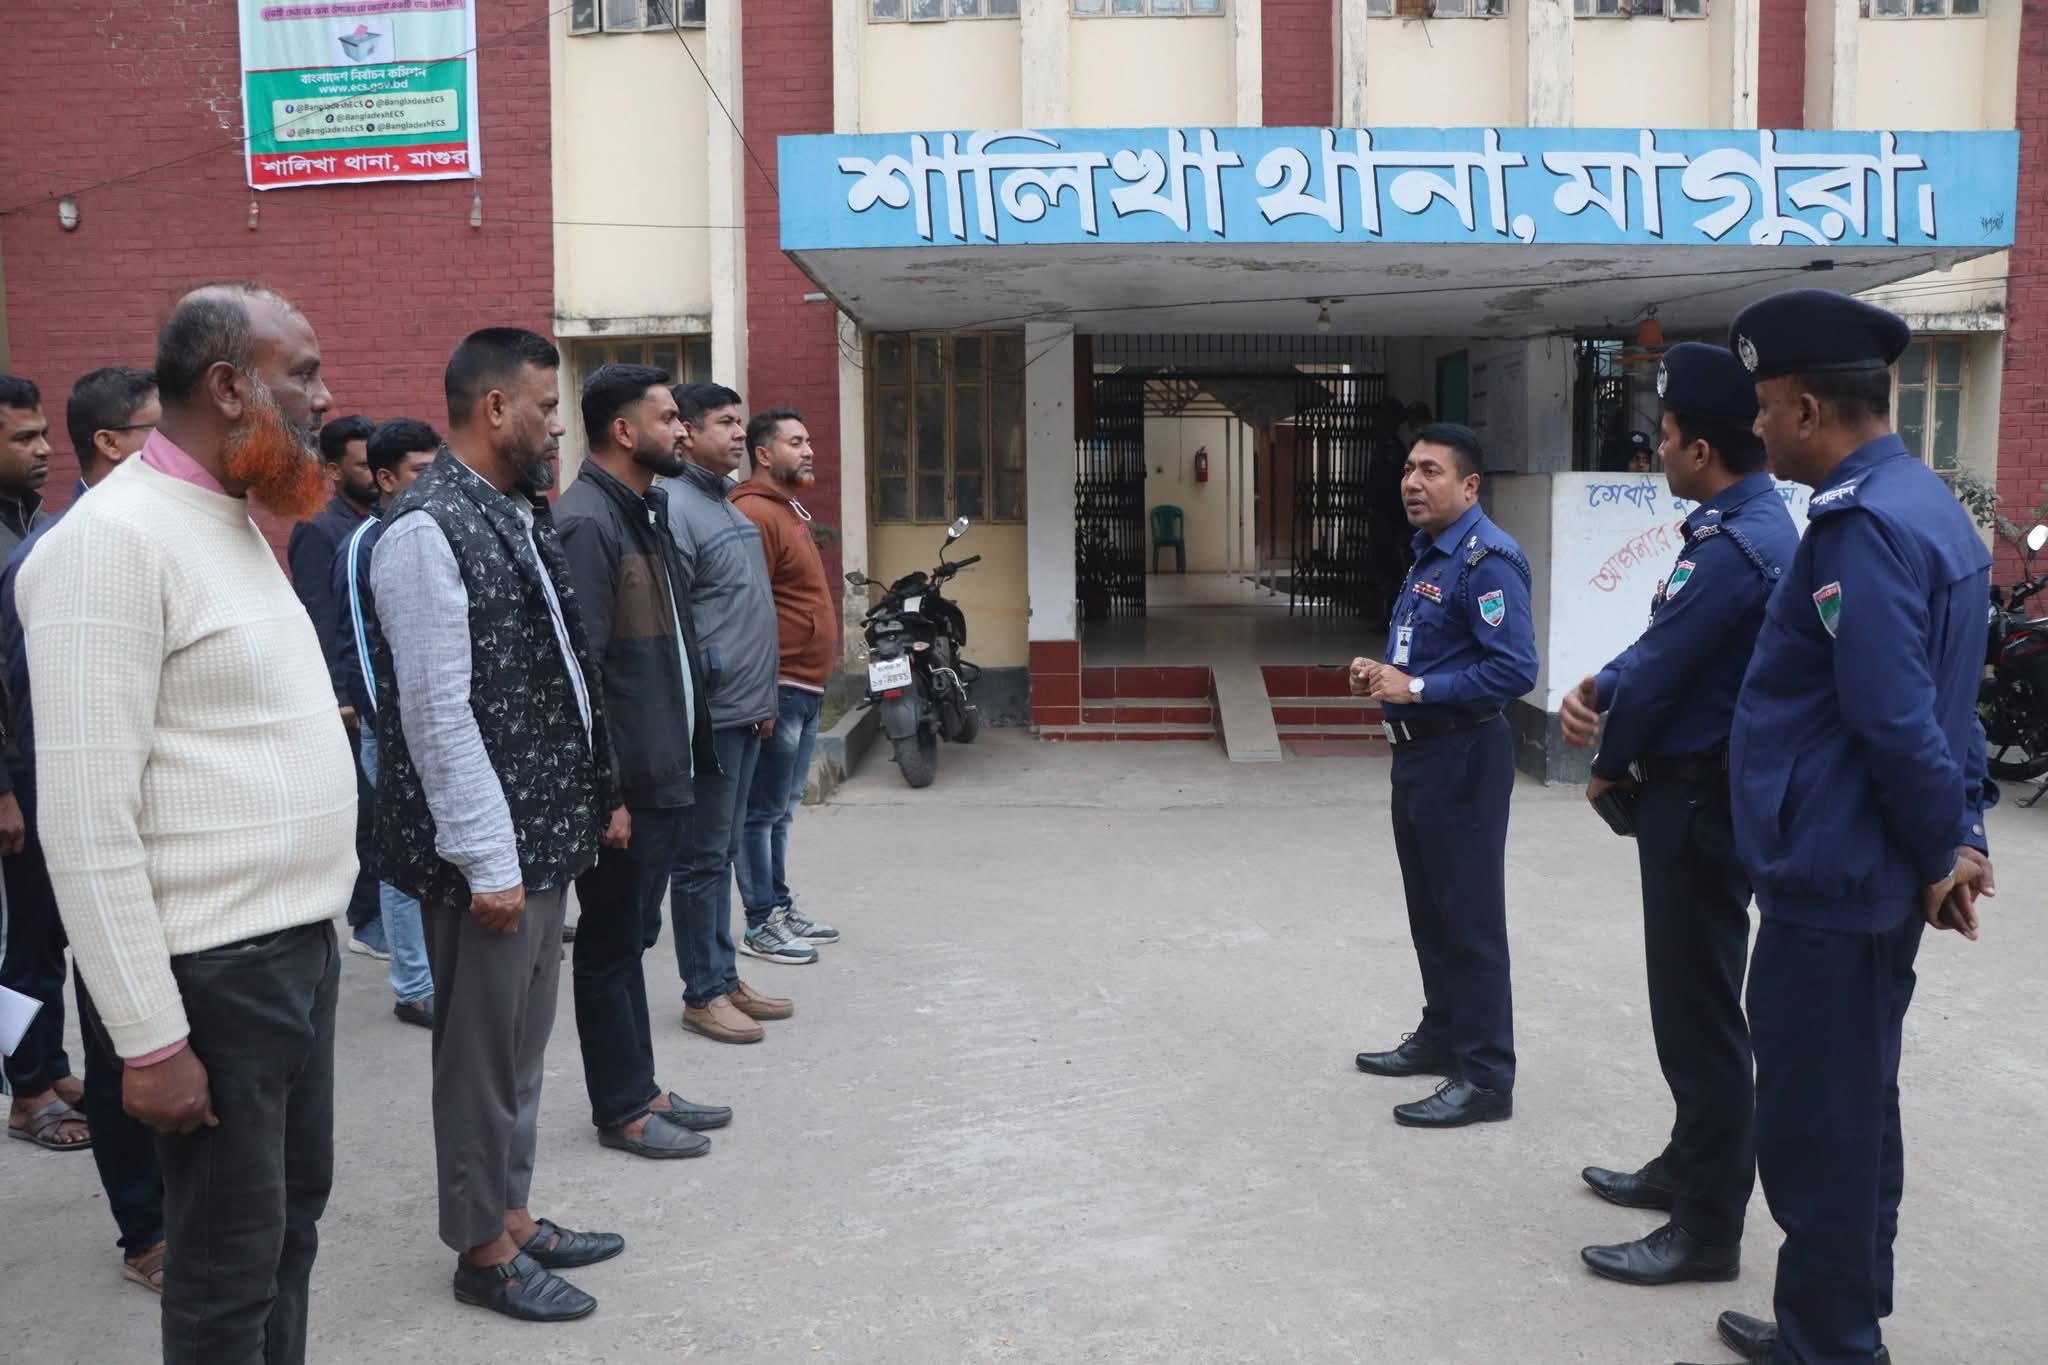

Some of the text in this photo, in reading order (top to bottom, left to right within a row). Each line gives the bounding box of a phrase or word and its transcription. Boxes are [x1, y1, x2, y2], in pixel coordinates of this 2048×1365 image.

[300, 71, 348, 85] বাংলাদেশ
[350, 67, 385, 81] নির্বাচন
[319, 79, 408, 95] www.ecs.gov.bd
[295, 95, 445, 114] @BangladeshECS @BangladeshECS
[336, 110, 404, 123] @BangladeshECS
[297, 119, 445, 138] @BangladeshECS @BangladeshECS
[261, 154, 336, 177] শালিখা
[344, 152, 400, 173] থানা,
[838, 127, 1242, 245] শালিখা
[1255, 127, 1536, 245] থানা,
[1586, 475, 1658, 516] সেবাই
